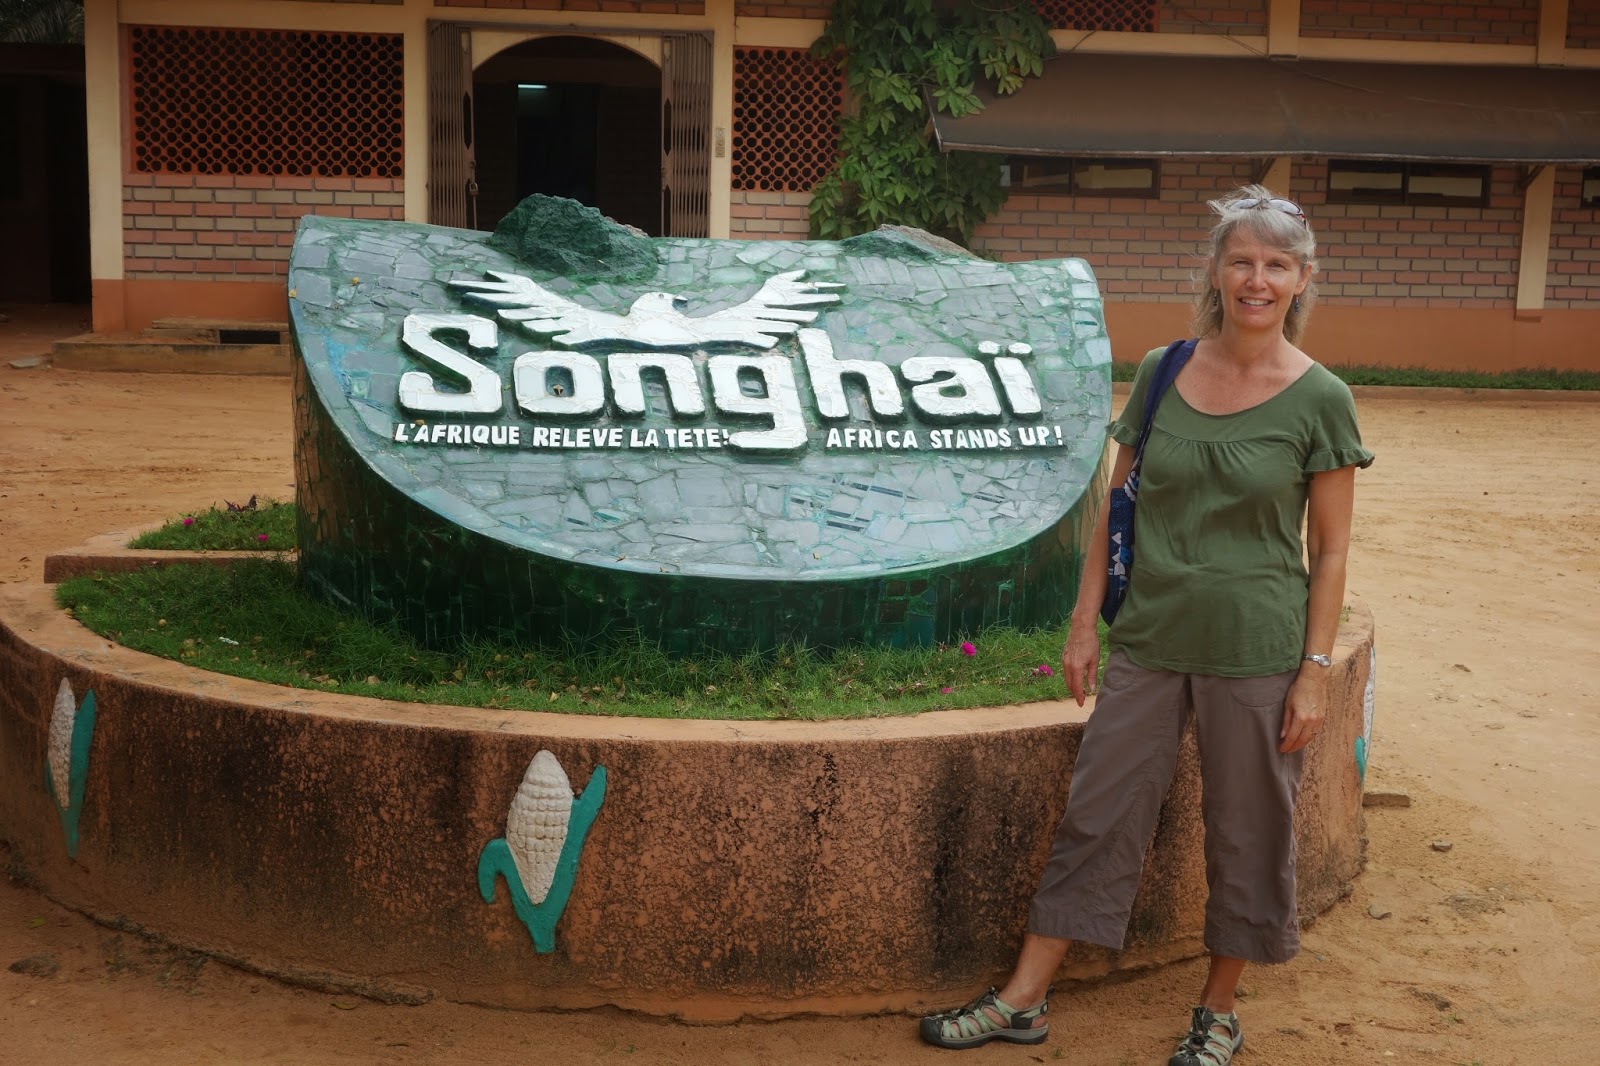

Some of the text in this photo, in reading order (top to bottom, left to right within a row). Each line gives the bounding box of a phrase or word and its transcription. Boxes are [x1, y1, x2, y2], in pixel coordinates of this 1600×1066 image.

[399, 313, 1041, 449] Songhaï
[394, 422, 729, 449] L'AFRIQUE RELEVE LA TETE!
[826, 425, 1063, 449] AFRICA STANDS UP!
